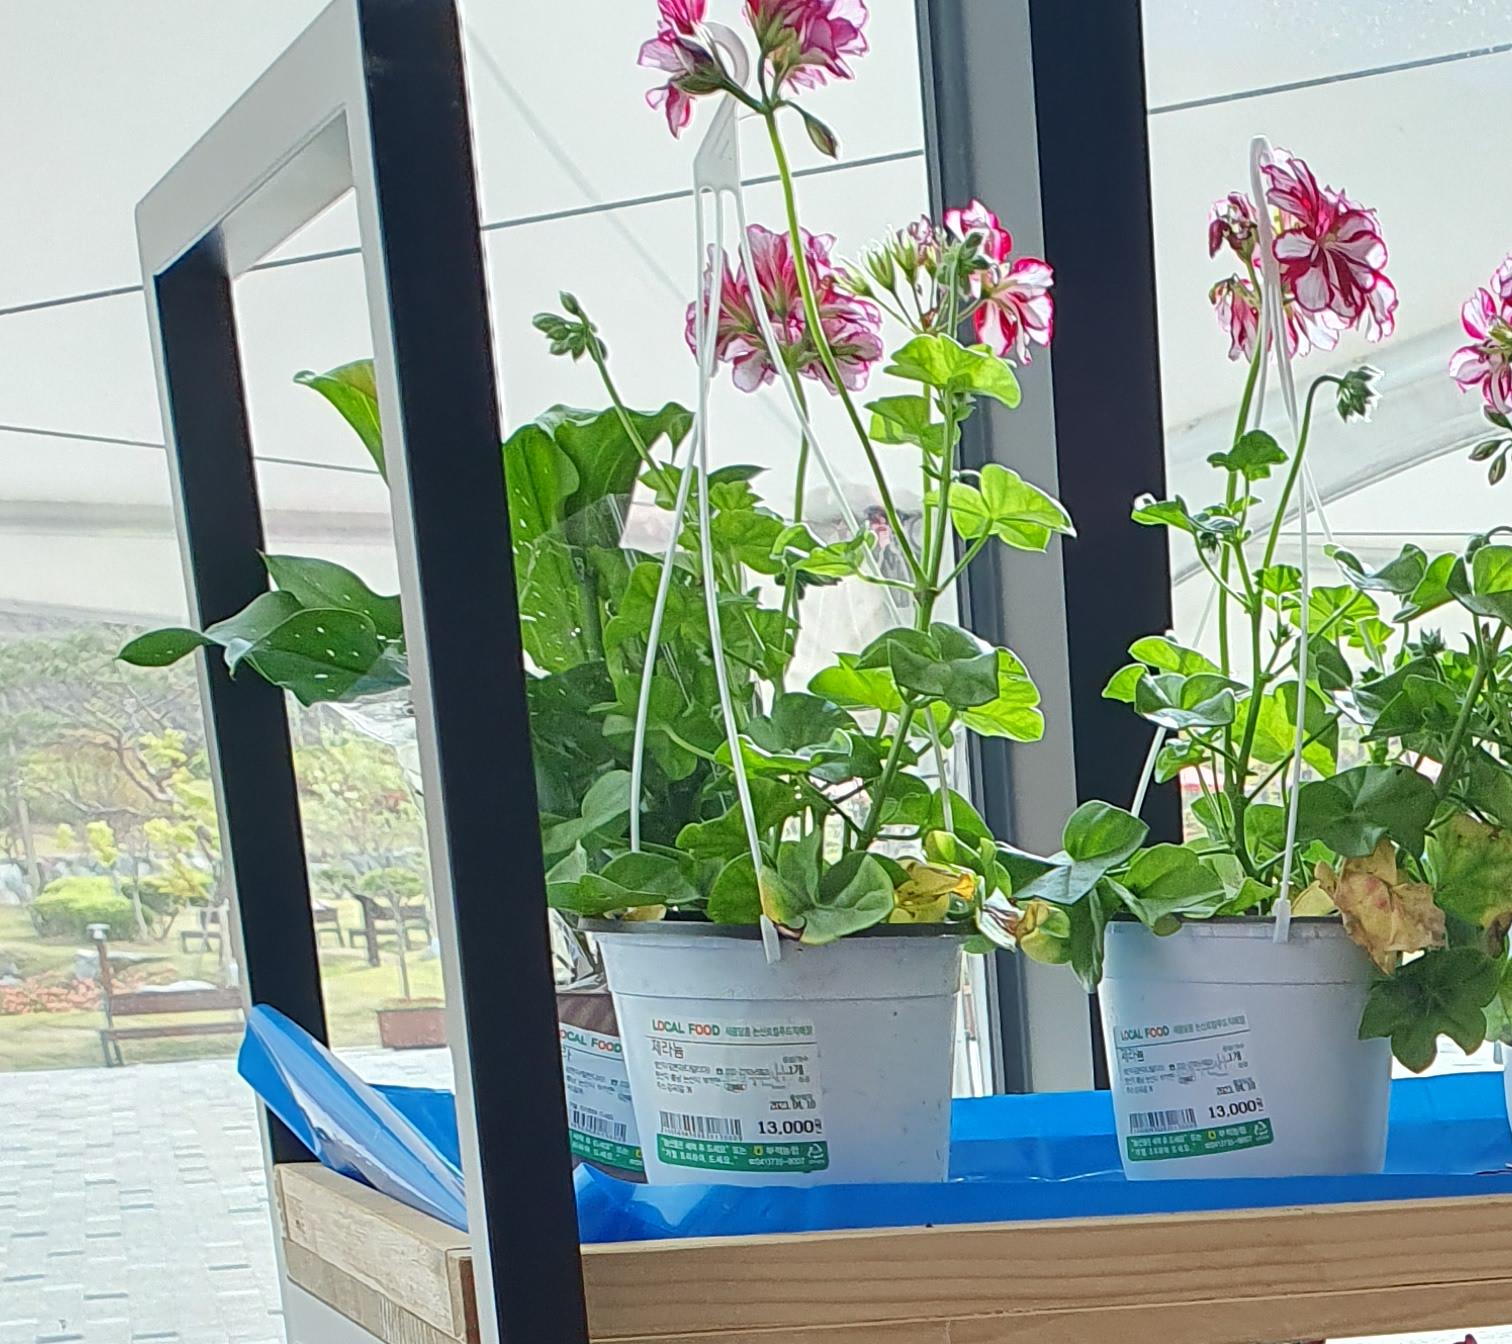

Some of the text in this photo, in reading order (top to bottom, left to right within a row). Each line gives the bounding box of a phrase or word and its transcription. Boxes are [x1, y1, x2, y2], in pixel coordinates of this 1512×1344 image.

[652, 1019, 685, 1034] LOCAL
[688, 1023, 720, 1036] FOOD
[1121, 1025, 1170, 1041] LOCAL FOOD
[560, 1029, 587, 1045] OCAL
